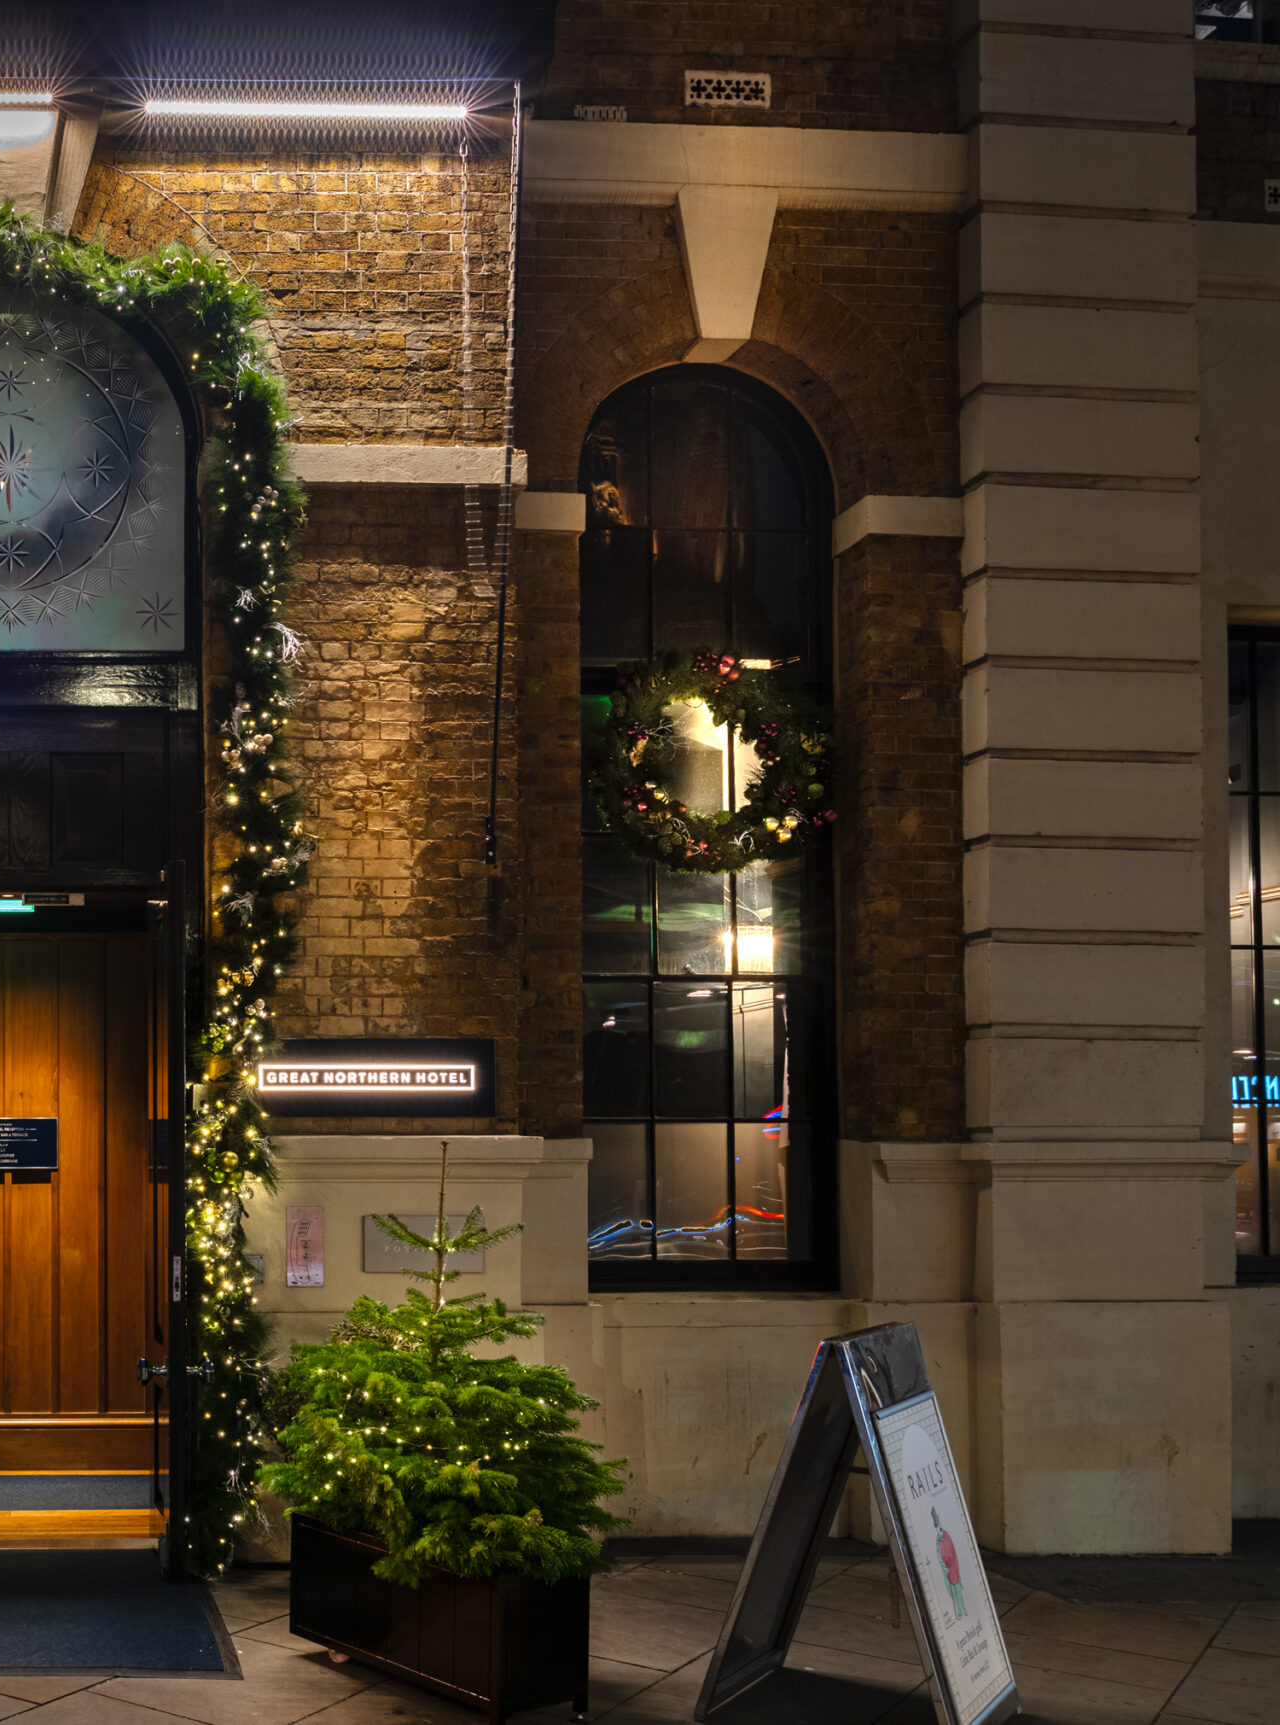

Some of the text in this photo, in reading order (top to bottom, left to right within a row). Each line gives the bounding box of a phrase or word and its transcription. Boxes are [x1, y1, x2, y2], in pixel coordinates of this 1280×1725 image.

[266, 1071, 468, 1085] GREAT NORTHERN HOTEL
[907, 1461, 943, 1499] RAILS
